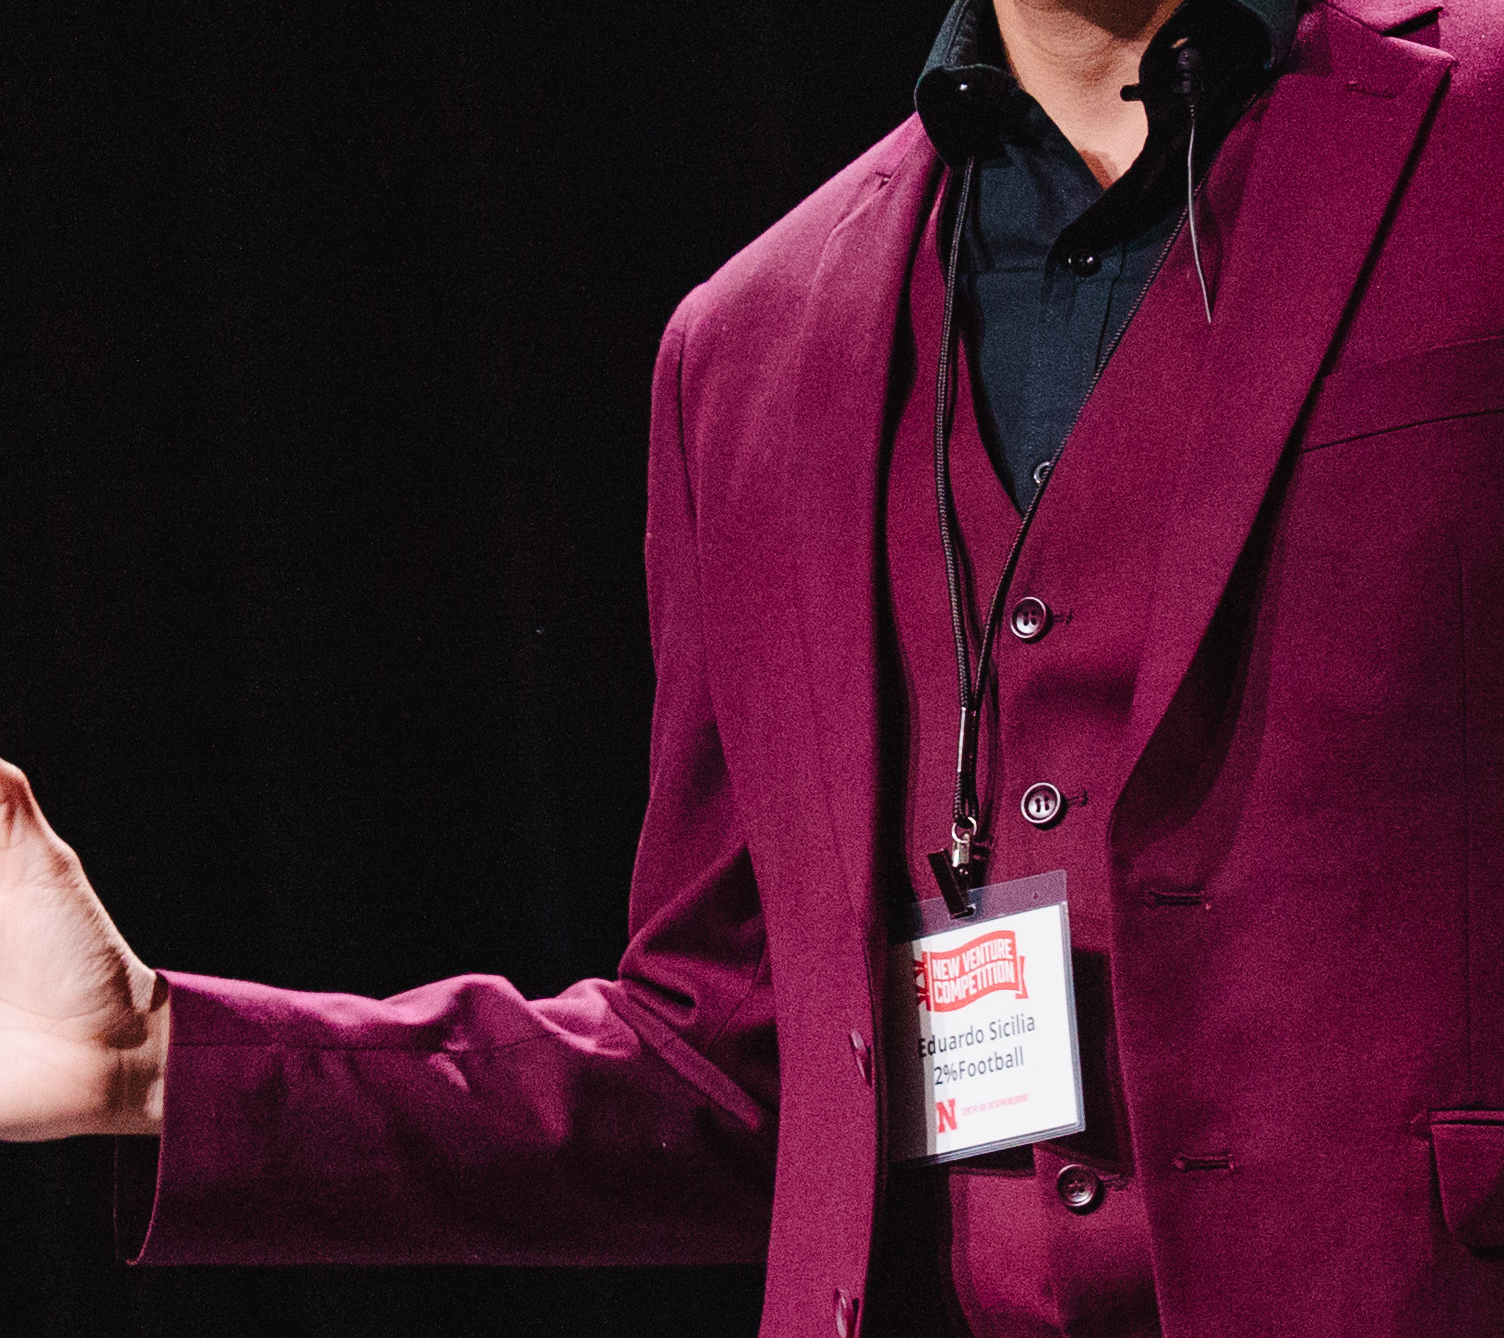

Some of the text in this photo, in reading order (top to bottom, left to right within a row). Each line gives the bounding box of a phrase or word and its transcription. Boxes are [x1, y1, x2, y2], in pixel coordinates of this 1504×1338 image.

[932, 938, 1014, 981] NEW VENTURE
[933, 959, 1016, 1004] COMPETITION
[917, 1013, 1036, 1058] Eduardo Sicilia
[933, 1045, 1025, 1085] 2%Football
[935, 1098, 958, 1134] N
